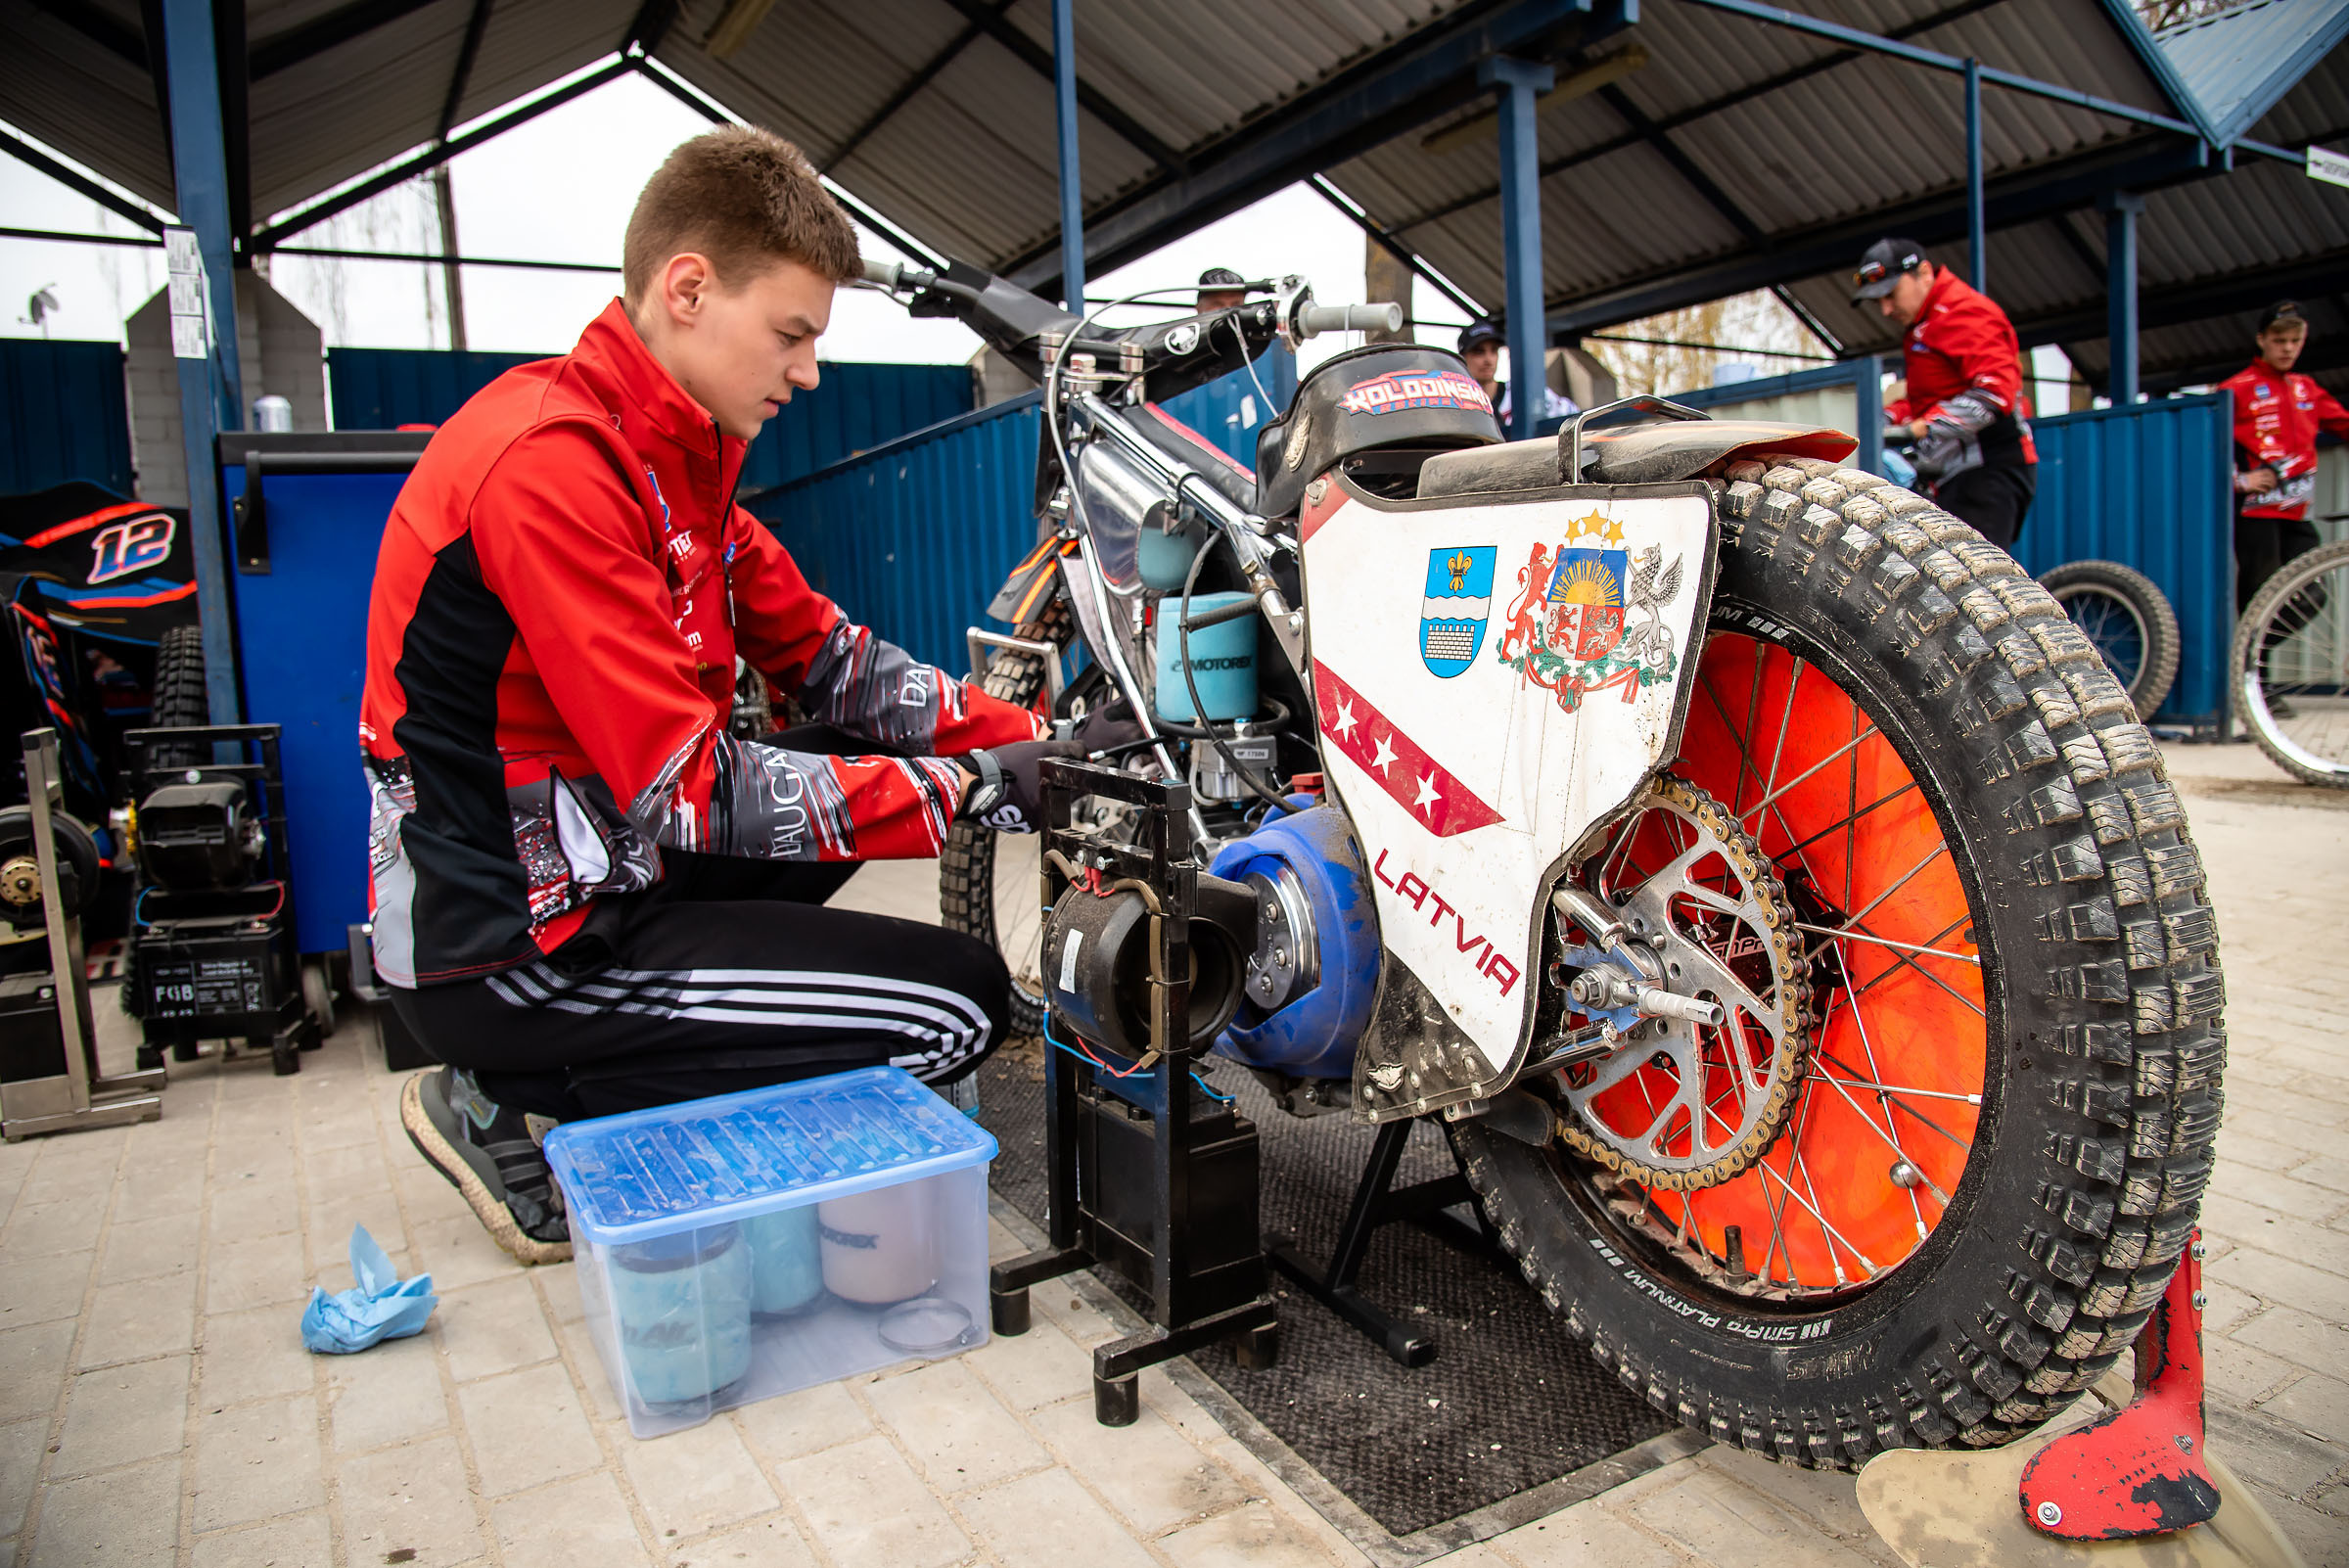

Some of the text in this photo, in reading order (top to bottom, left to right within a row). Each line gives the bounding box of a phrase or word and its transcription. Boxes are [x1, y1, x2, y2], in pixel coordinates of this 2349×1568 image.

[86, 513, 176, 584] 12
[1374, 848, 1521, 998] LATVIA
[1623, 1269, 1722, 1329] PLATINUM
